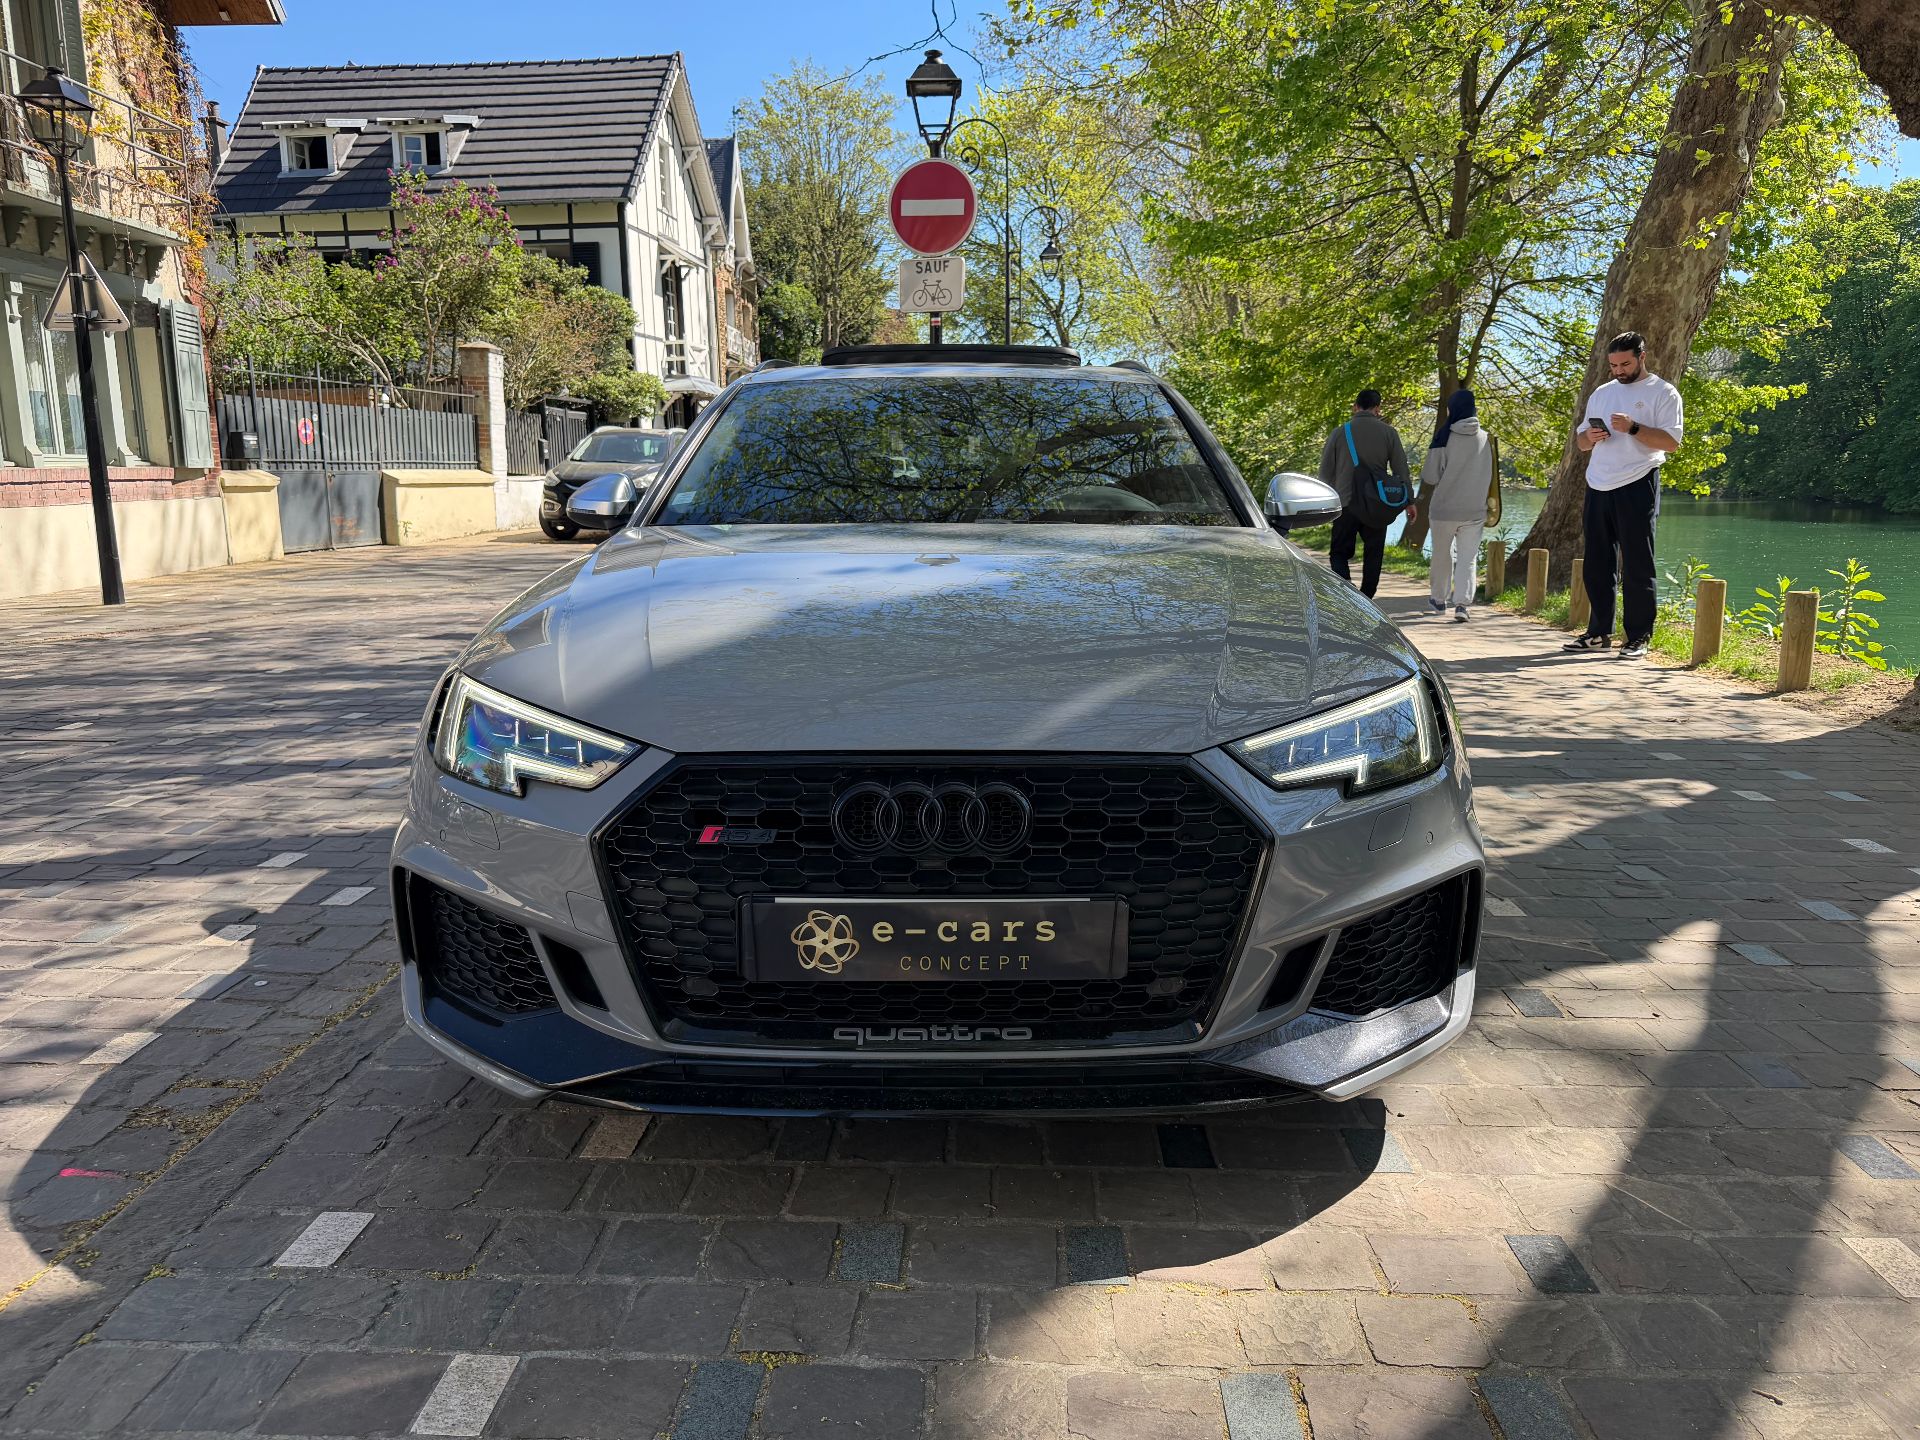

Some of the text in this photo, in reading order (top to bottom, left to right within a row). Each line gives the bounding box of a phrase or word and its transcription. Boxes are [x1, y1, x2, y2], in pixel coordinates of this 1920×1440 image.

[915, 260, 950, 274] SAUF
[872, 920, 1056, 943] e-cars
[900, 955, 1030, 971] CONCEPT
[833, 1024, 1033, 1046] quattro
